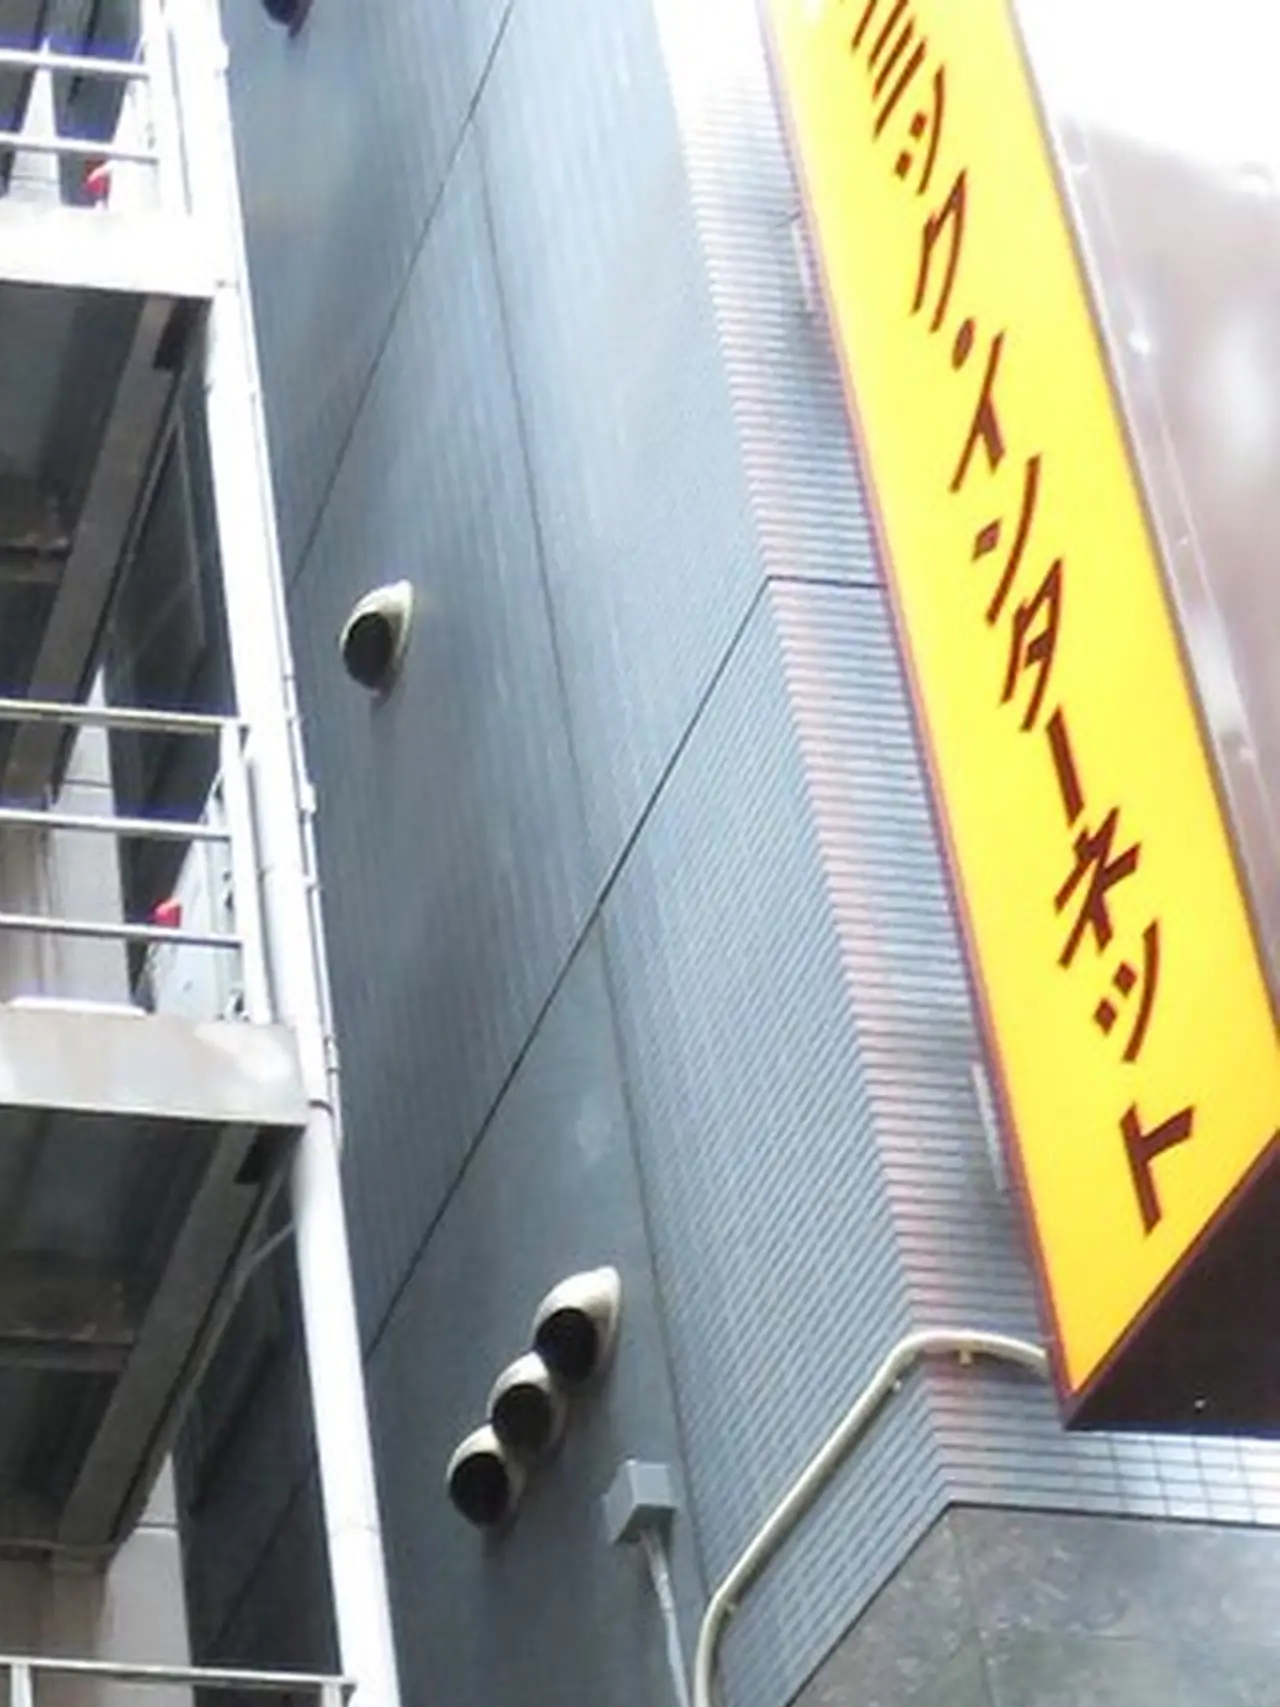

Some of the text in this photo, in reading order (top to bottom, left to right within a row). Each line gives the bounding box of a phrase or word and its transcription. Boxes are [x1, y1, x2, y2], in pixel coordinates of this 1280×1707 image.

[849, 0, 1196, 1237] ミック・インターネット
